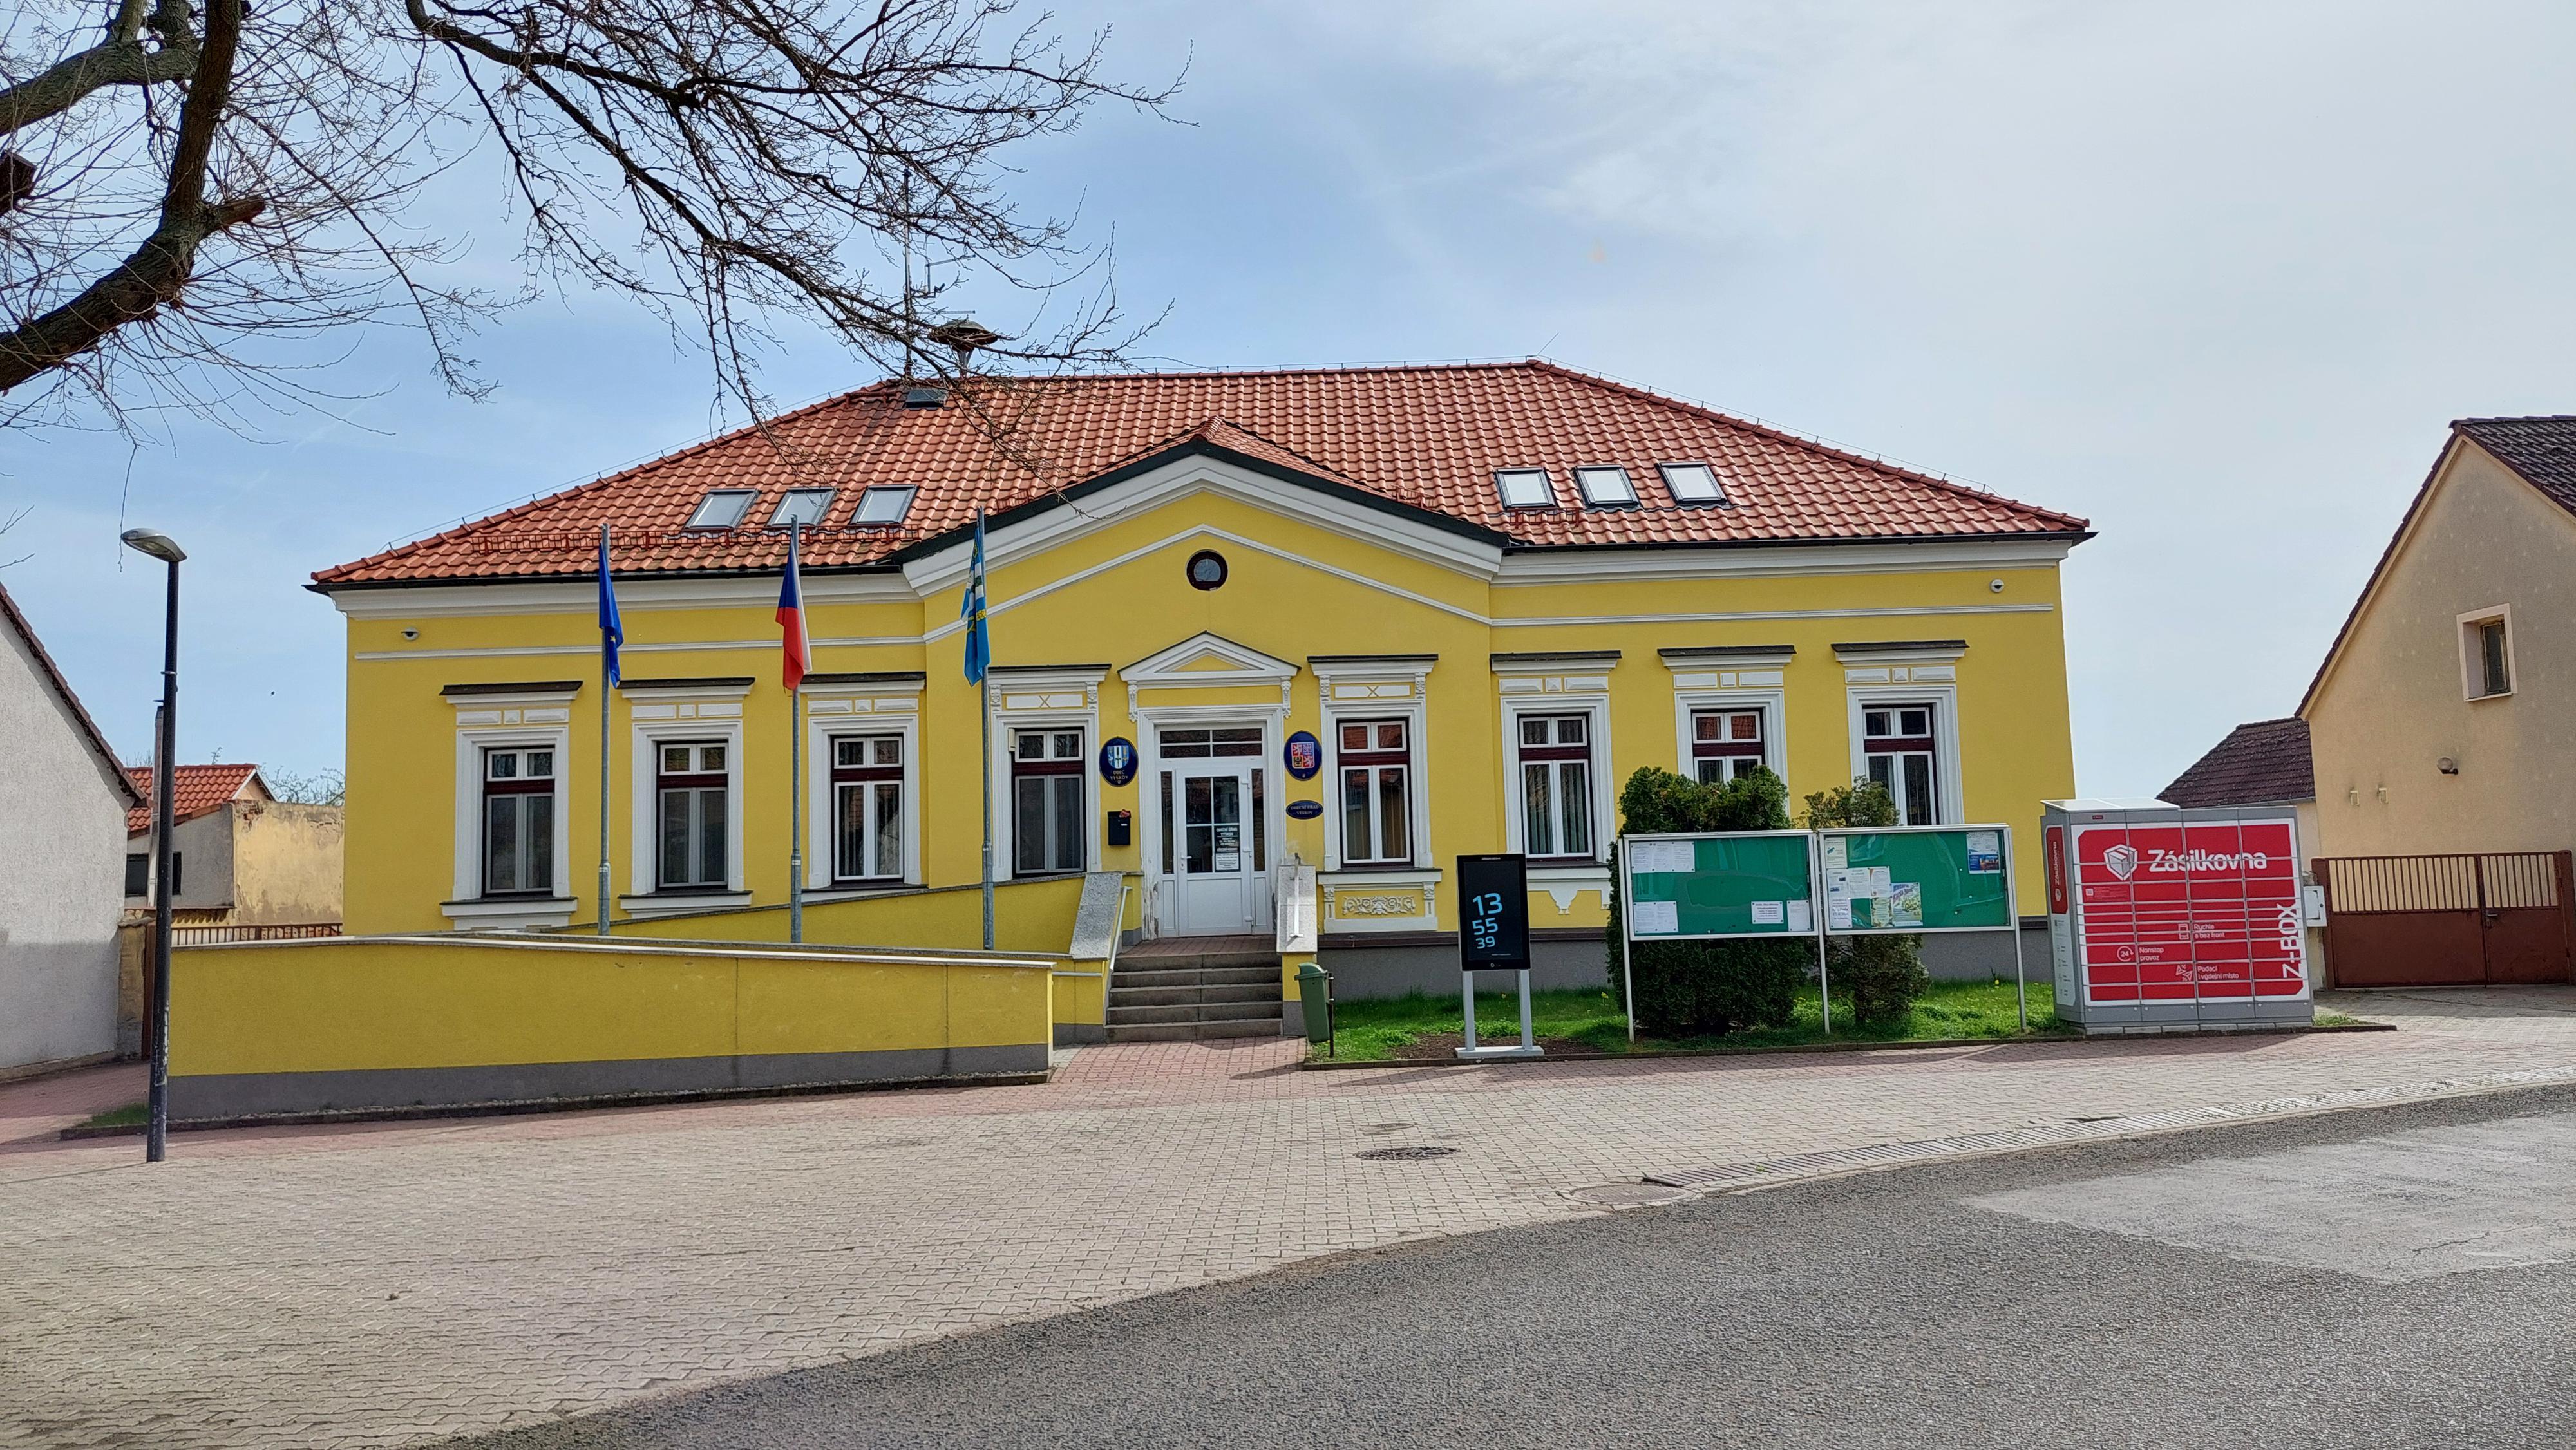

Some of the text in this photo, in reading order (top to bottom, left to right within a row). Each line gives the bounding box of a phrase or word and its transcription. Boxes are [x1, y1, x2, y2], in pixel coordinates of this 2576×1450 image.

[2147, 849, 2267, 872] Zásilkovna
[1472, 892, 1503, 916] 13
[1472, 918, 1499, 935] 55
[2193, 923, 2215, 932] Rychle
[1475, 936, 1495, 949] 39
[2277, 903, 2303, 978] Z-BOX
[2201, 972, 2222, 981] výdejní
